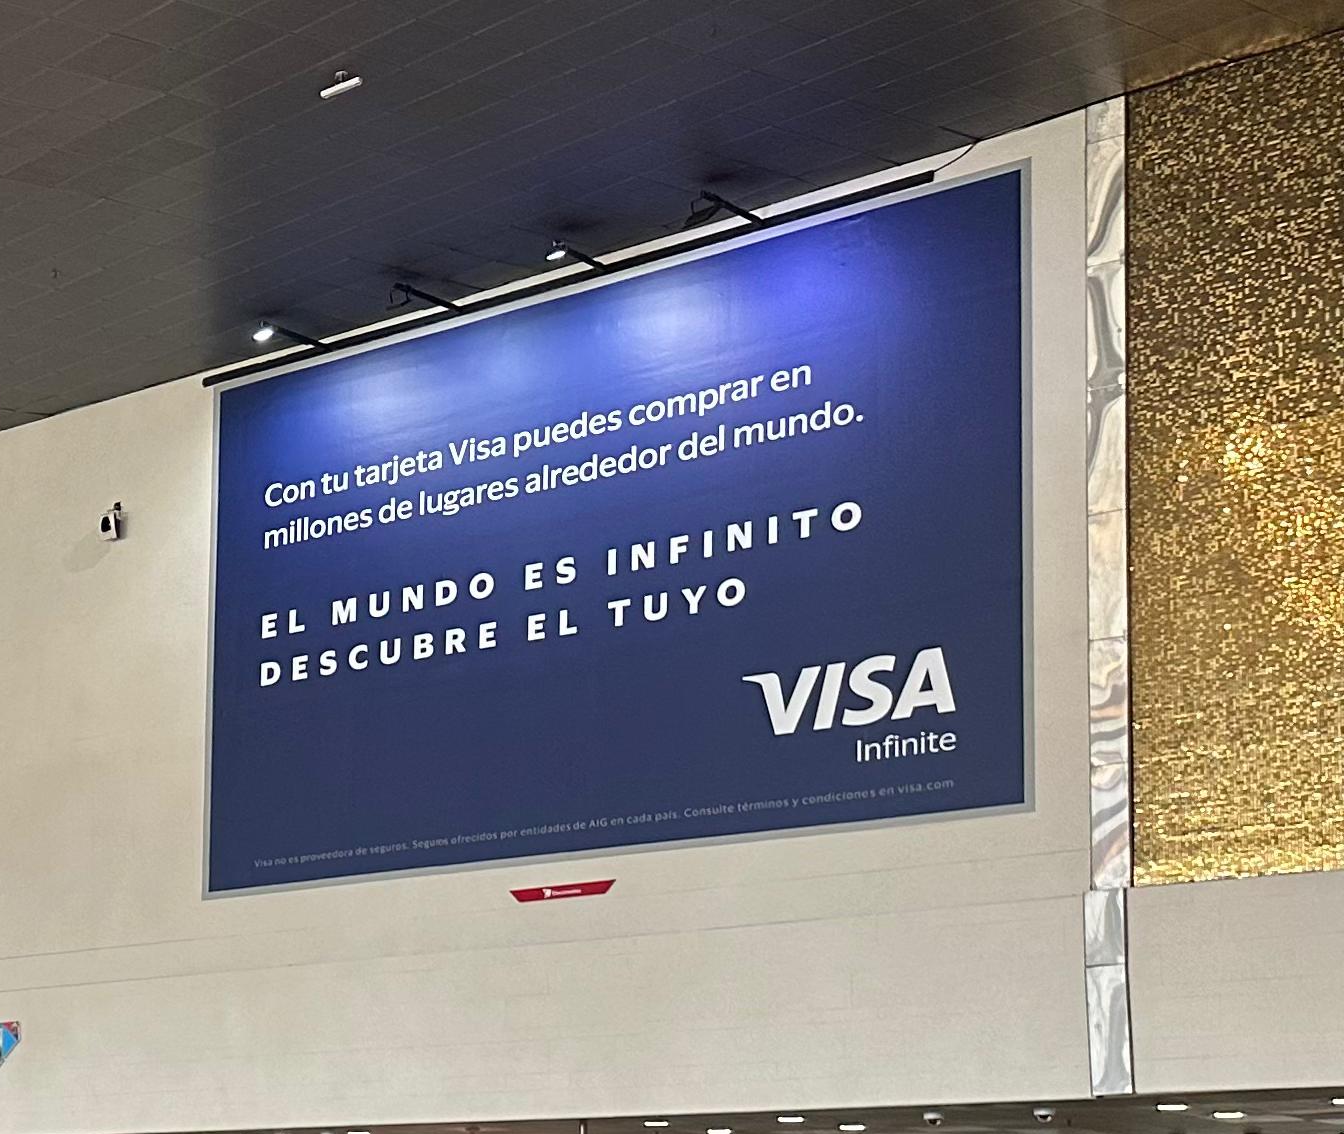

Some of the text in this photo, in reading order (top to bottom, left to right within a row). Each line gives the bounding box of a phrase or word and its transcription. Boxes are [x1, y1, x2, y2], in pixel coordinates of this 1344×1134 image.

[264, 365, 812, 507] Con tu tarjeta Visa puedes comprar en
[264, 401, 864, 549] millones de lugares alrededor del mundo.
[262, 501, 864, 639] EL MUNDO ES INFINITO
[259, 577, 746, 687] DESCUBRE EL TUYO
[742, 646, 956, 736] VISA
[856, 731, 957, 762] Infinite
[254, 857, 273, 868] Visa
[274, 856, 287, 866] no
[288, 855, 299, 864] es
[300, 848, 354, 865] proveedora
[355, 845, 367, 856] de
[412, 837, 449, 851] Seguros
[451, 830, 498, 846] ofrecidos
[500, 828, 518, 841] por
[520, 822, 571, 838] entidades
[573, 820, 586, 831] de
[588, 817, 608, 829] AIG
[611, 815, 624, 826] en
[626, 810, 652, 825] cada
[654, 807, 682, 824] país.
[684, 802, 735, 819] Consulte
[736, 797, 790, 815] términos
[791, 798, 799, 810] y
[801, 787, 877, 806] condiciones
[879, 786, 895, 797] en
[897, 778, 955, 795] visa.com
